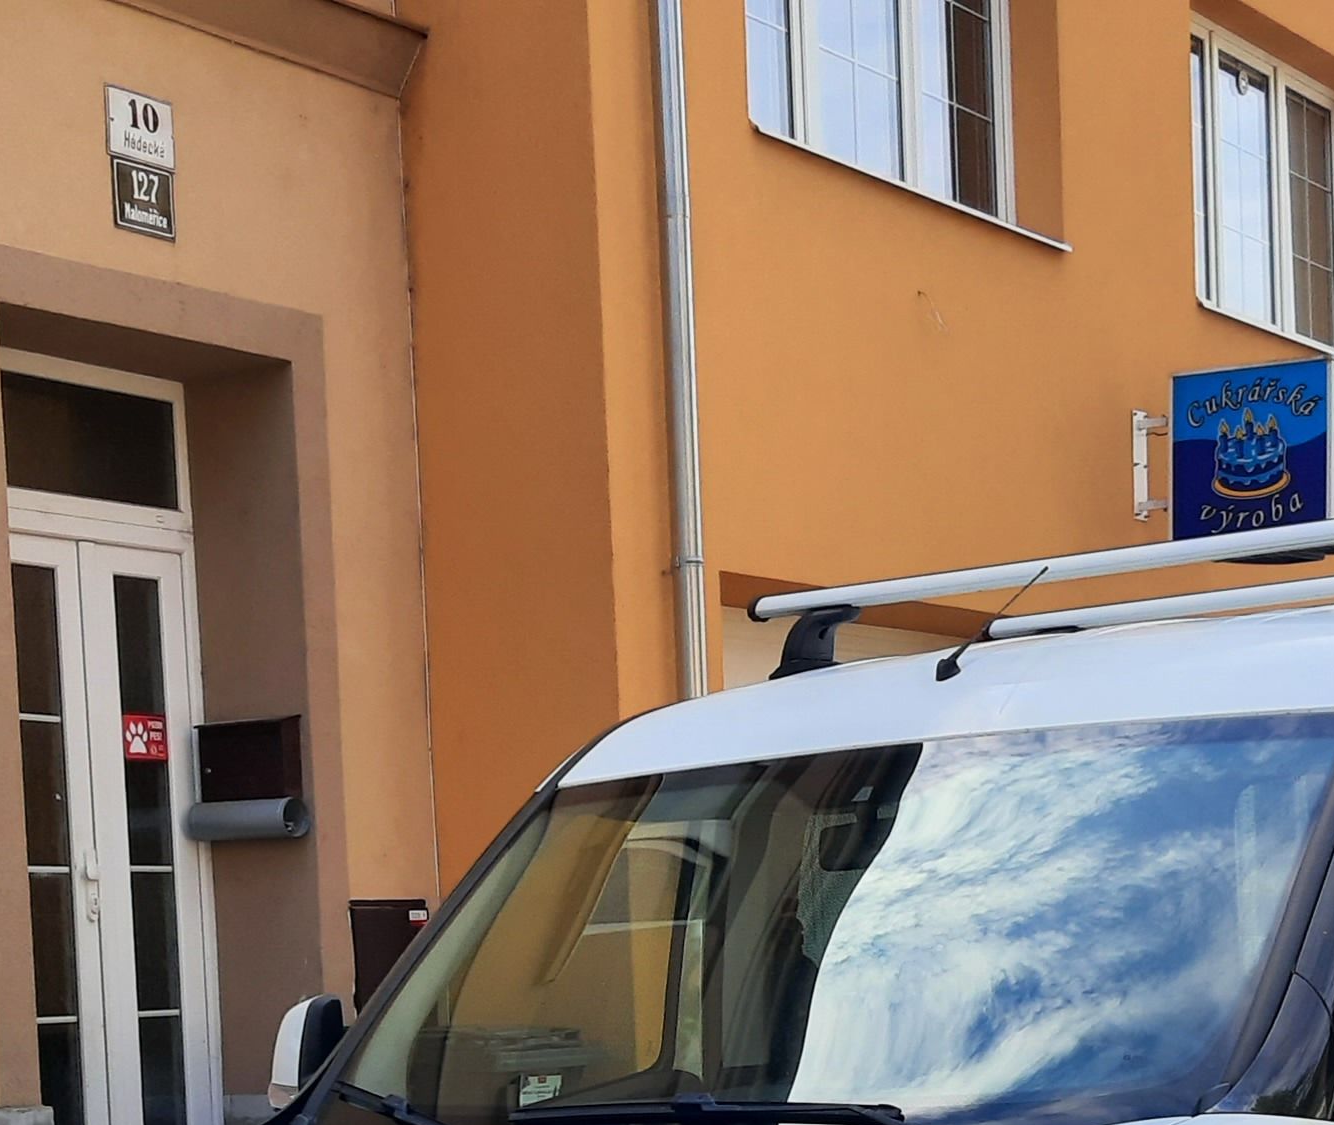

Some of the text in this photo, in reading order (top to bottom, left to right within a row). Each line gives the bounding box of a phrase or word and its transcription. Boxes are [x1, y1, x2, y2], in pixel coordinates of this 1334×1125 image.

[128, 99, 159, 133] 10
[132, 170, 159, 204] 127
[1187, 376, 1322, 427] Cukrářská
[1200, 493, 1303, 533] výroba
